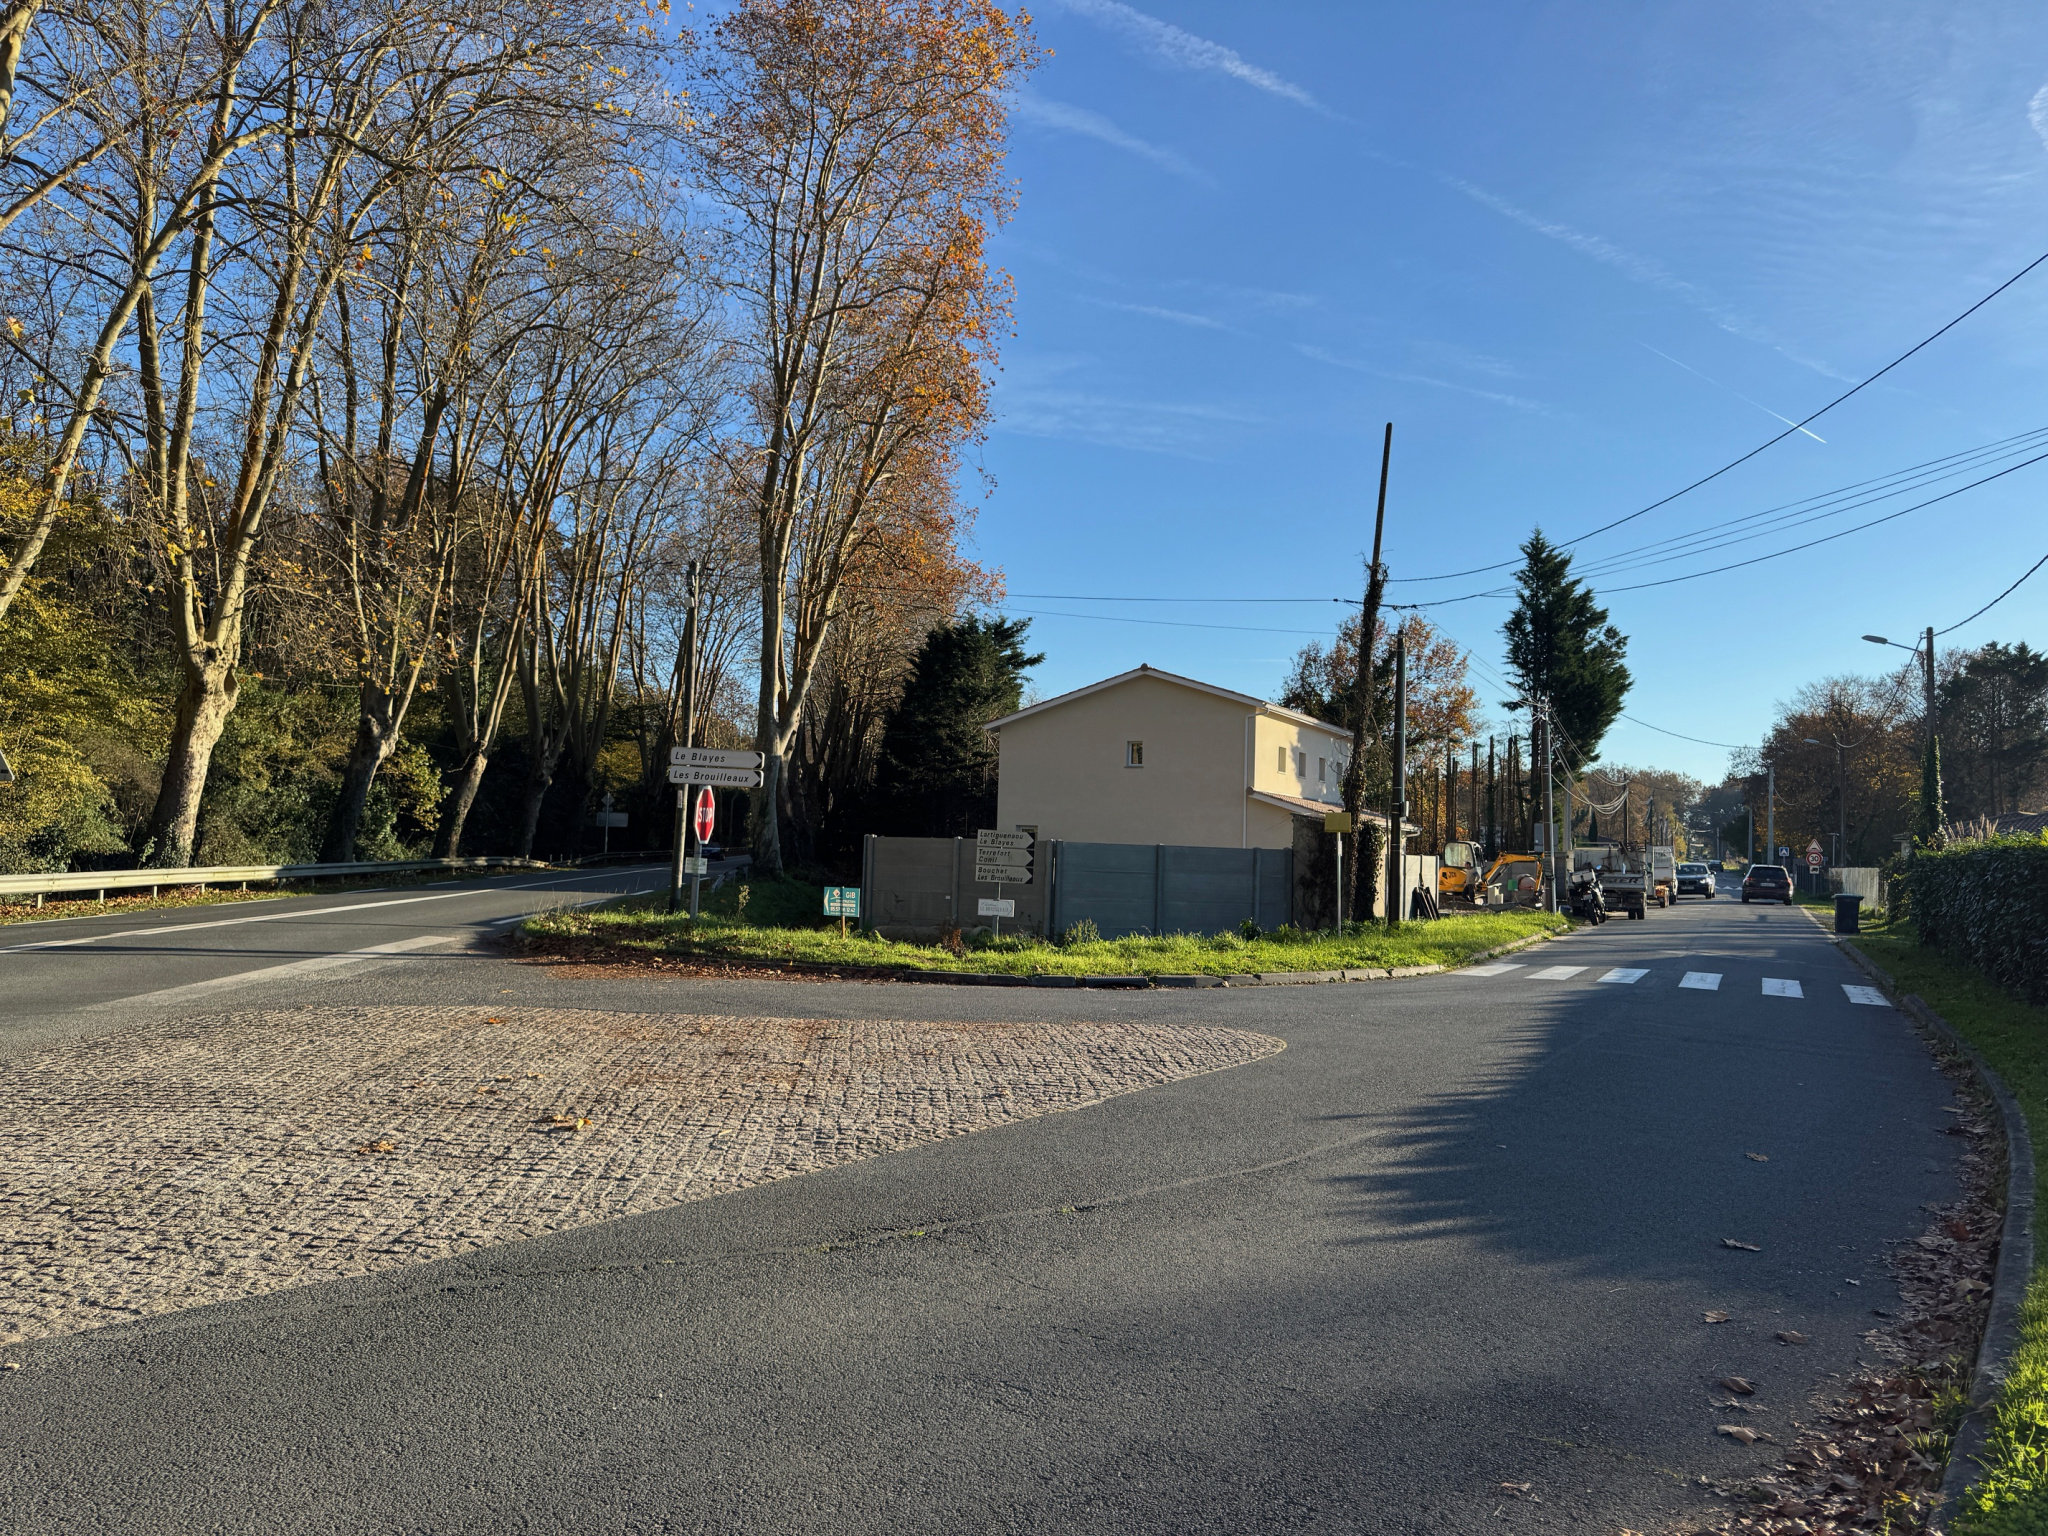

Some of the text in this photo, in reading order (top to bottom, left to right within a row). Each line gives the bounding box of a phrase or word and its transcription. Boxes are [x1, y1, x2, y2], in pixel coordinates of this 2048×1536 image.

[675, 751, 726, 764] Le Blayes
[673, 770, 750, 783] Les Brouilleaux
[698, 807, 712, 824] STOP
[991, 838, 1014, 846] Blayes
[978, 866, 1008, 874] Bouchet
[978, 873, 988, 881] Les
